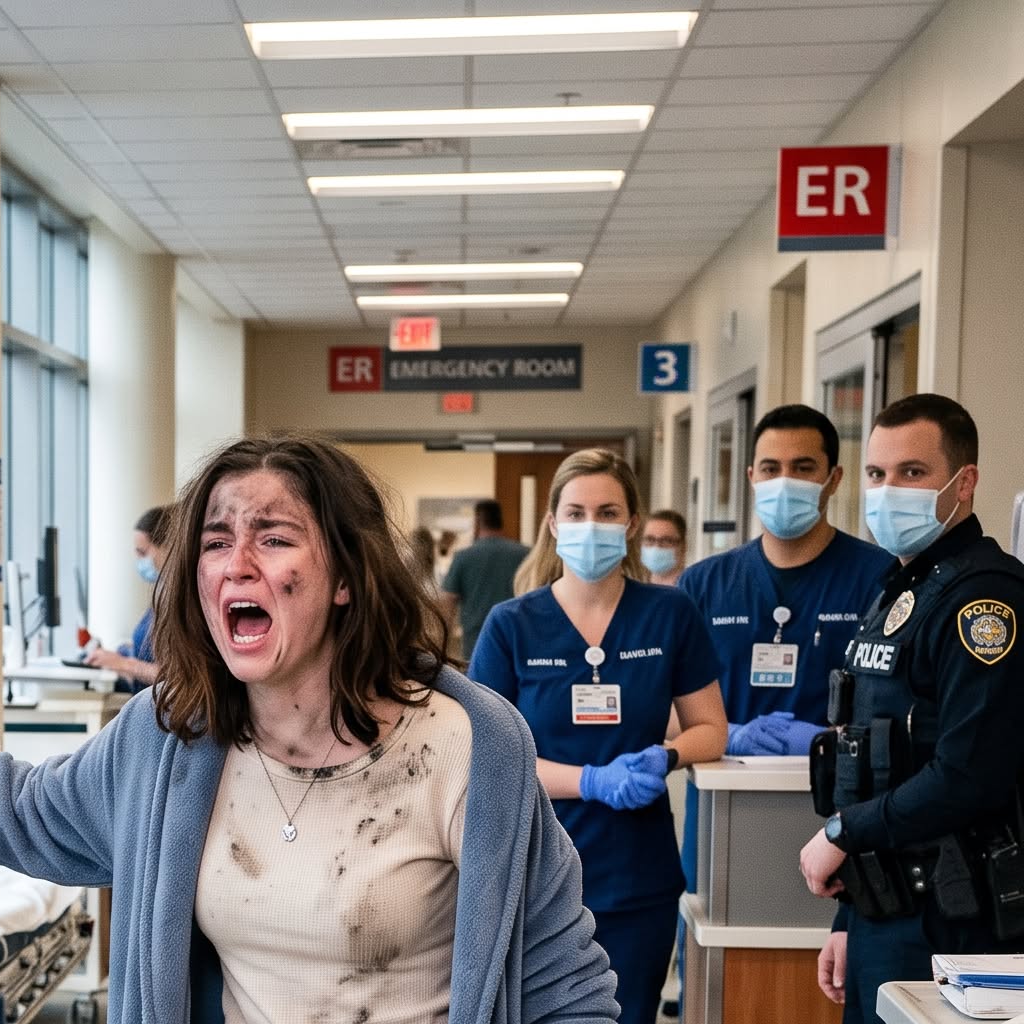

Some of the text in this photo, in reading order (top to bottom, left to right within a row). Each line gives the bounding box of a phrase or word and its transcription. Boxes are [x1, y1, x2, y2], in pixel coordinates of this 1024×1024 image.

[796, 165, 871, 217] ER
[336, 356, 373, 383] ER
[389, 358, 575, 378] EMERGENCY ROOM
[653, 350, 678, 386] 3
[963, 604, 1010, 620] POLICE
[853, 642, 895, 671] POLICE
